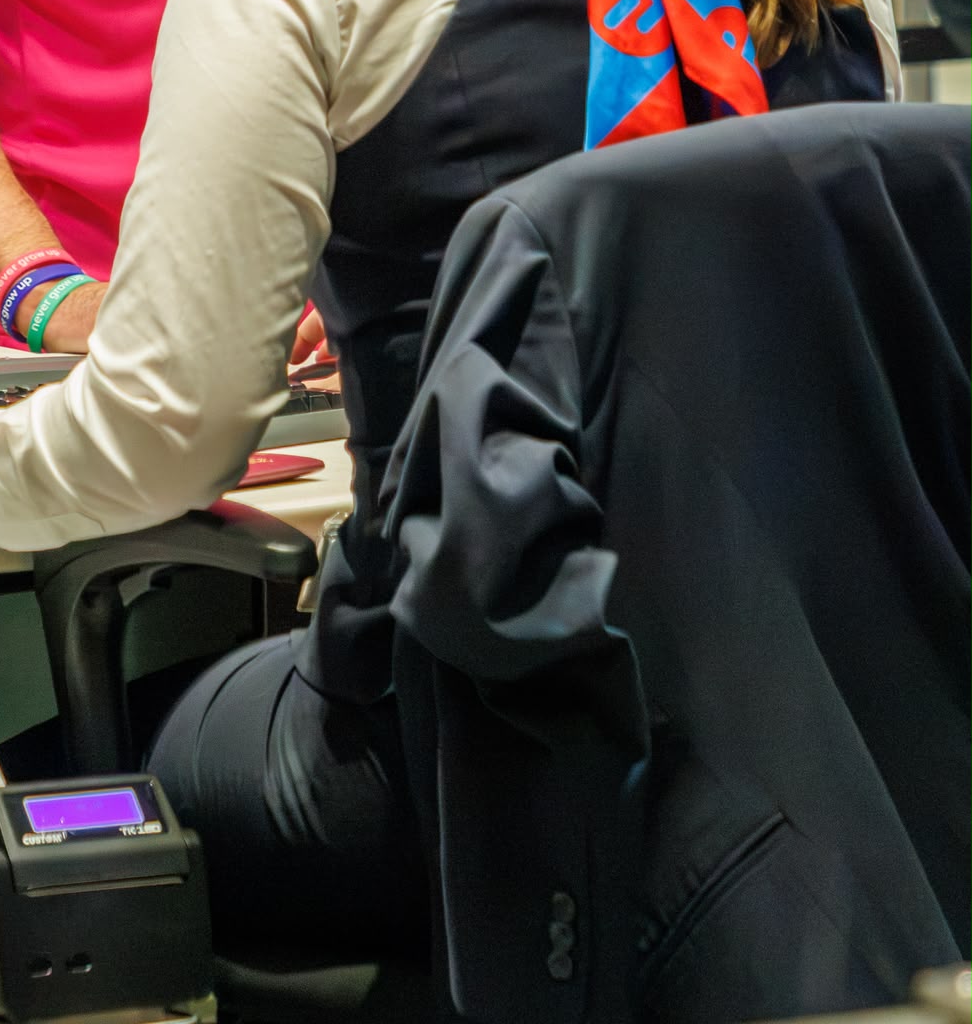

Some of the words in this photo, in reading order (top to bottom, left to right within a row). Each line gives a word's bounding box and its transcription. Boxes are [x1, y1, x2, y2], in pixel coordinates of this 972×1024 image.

[17, 251, 46, 268] grow
[45, 248, 61, 257] up
[1, 289, 19, 320] grow
[16, 277, 33, 291] up
[31, 298, 52, 332] never
[48, 279, 73, 301] grow
[70, 274, 86, 283] up
